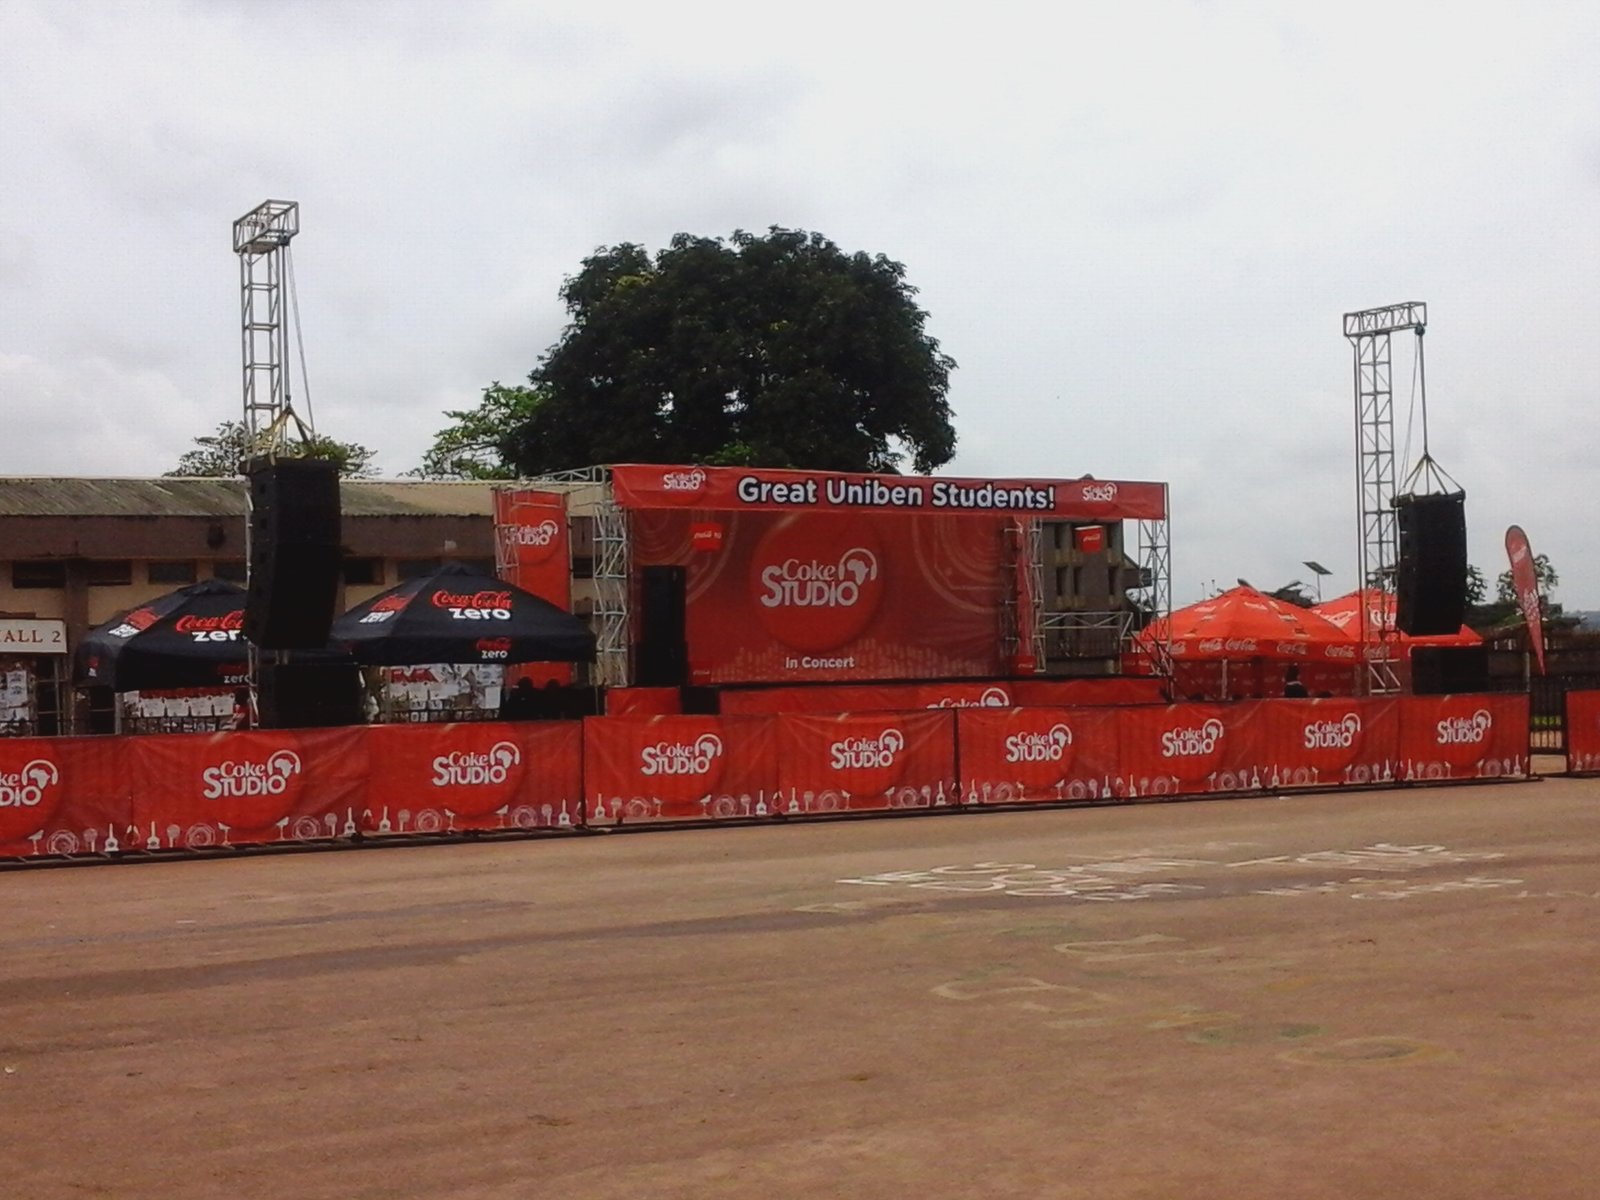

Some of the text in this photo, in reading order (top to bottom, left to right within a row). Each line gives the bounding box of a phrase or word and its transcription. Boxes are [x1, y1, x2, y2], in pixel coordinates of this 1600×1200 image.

[737, 477, 1056, 510] Great Uniben Students!
[782, 558, 836, 581] Coke
[448, 608, 511, 620] zero
[0, 629, 62, 643] ALL 2
[192, 629, 247, 642] zer
[481, 650, 509, 659] zero
[785, 656, 855, 669] In Concert
[843, 737, 878, 753] Coke
[1017, 731, 1048, 747] Coke
[657, 742, 693, 759] Coke
[448, 751, 489, 767] Coke
[220, 760, 266, 778] Coke
[0, 771, 20, 787] ke
[0, 785, 42, 807] DIO
